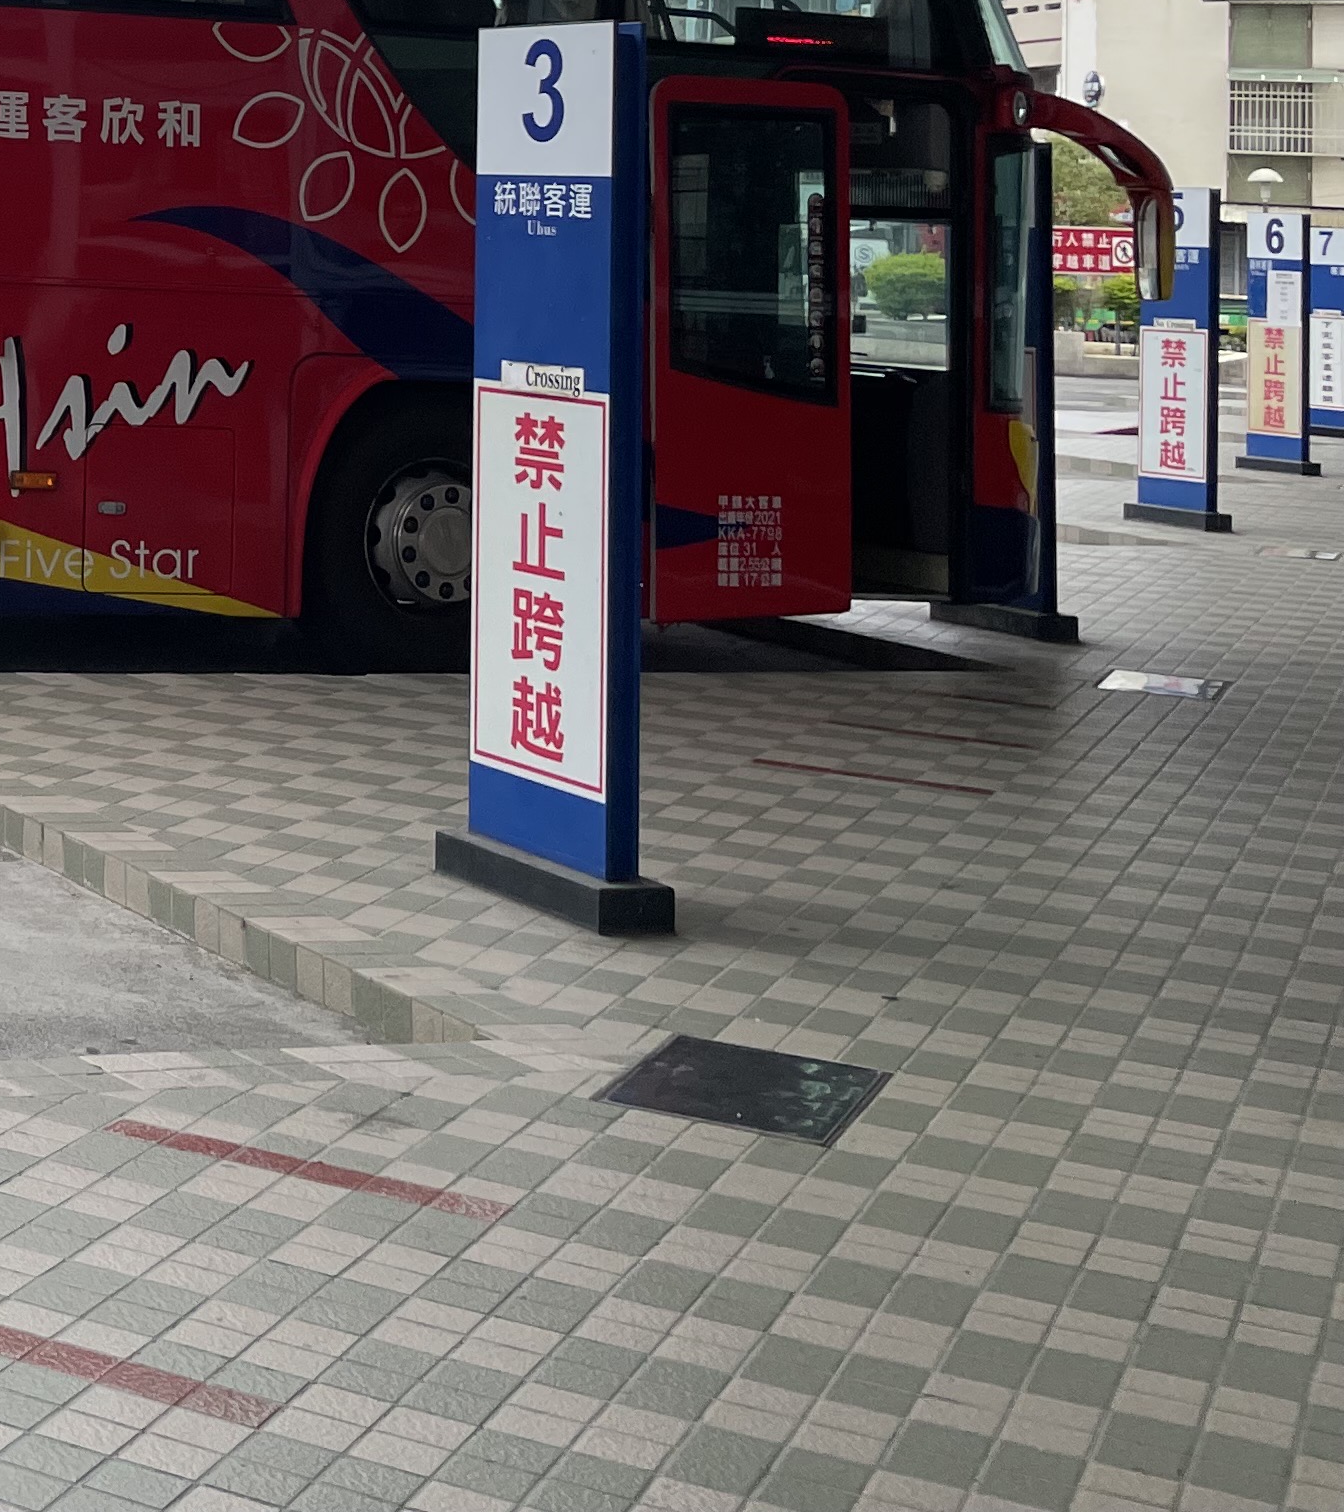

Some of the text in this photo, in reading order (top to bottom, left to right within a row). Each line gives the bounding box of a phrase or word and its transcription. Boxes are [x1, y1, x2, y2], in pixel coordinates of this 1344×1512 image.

[521, 39, 564, 143] 3
[494, 181, 593, 219] 統聯客運
[527, 220, 556, 236] Ubus
[1265, 218, 1284, 254] 6
[1319, 231, 1333, 255] 7
[526, 365, 580, 397] Crossing
[1264, 327, 1285, 429] 禁止跨越
[1160, 338, 1186, 470] 禁止跨越
[718, 526, 782, 541] KKA-7798
[743, 542, 757, 556] 31
[0, 539, 200, 579] Five Star
[511, 413, 565, 764] 禁止跨越
